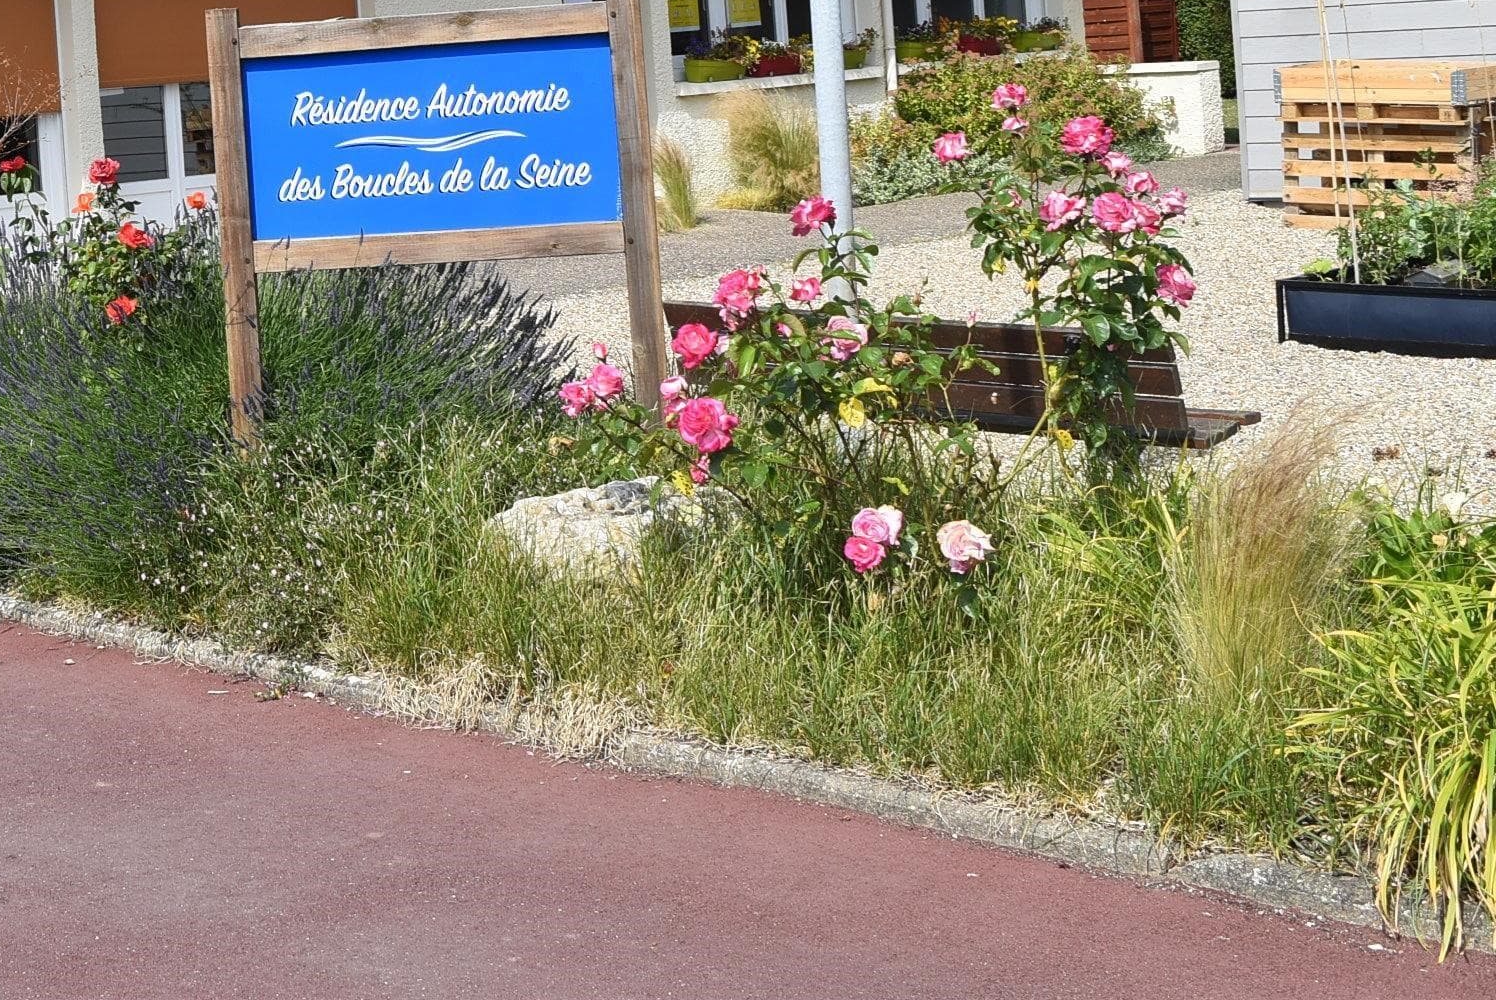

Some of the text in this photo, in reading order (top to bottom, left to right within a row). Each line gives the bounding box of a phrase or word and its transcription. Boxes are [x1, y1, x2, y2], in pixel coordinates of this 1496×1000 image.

[291, 82, 571, 127] Résidence Autonomie
[278, 153, 592, 202] des Boucles de la Seine
